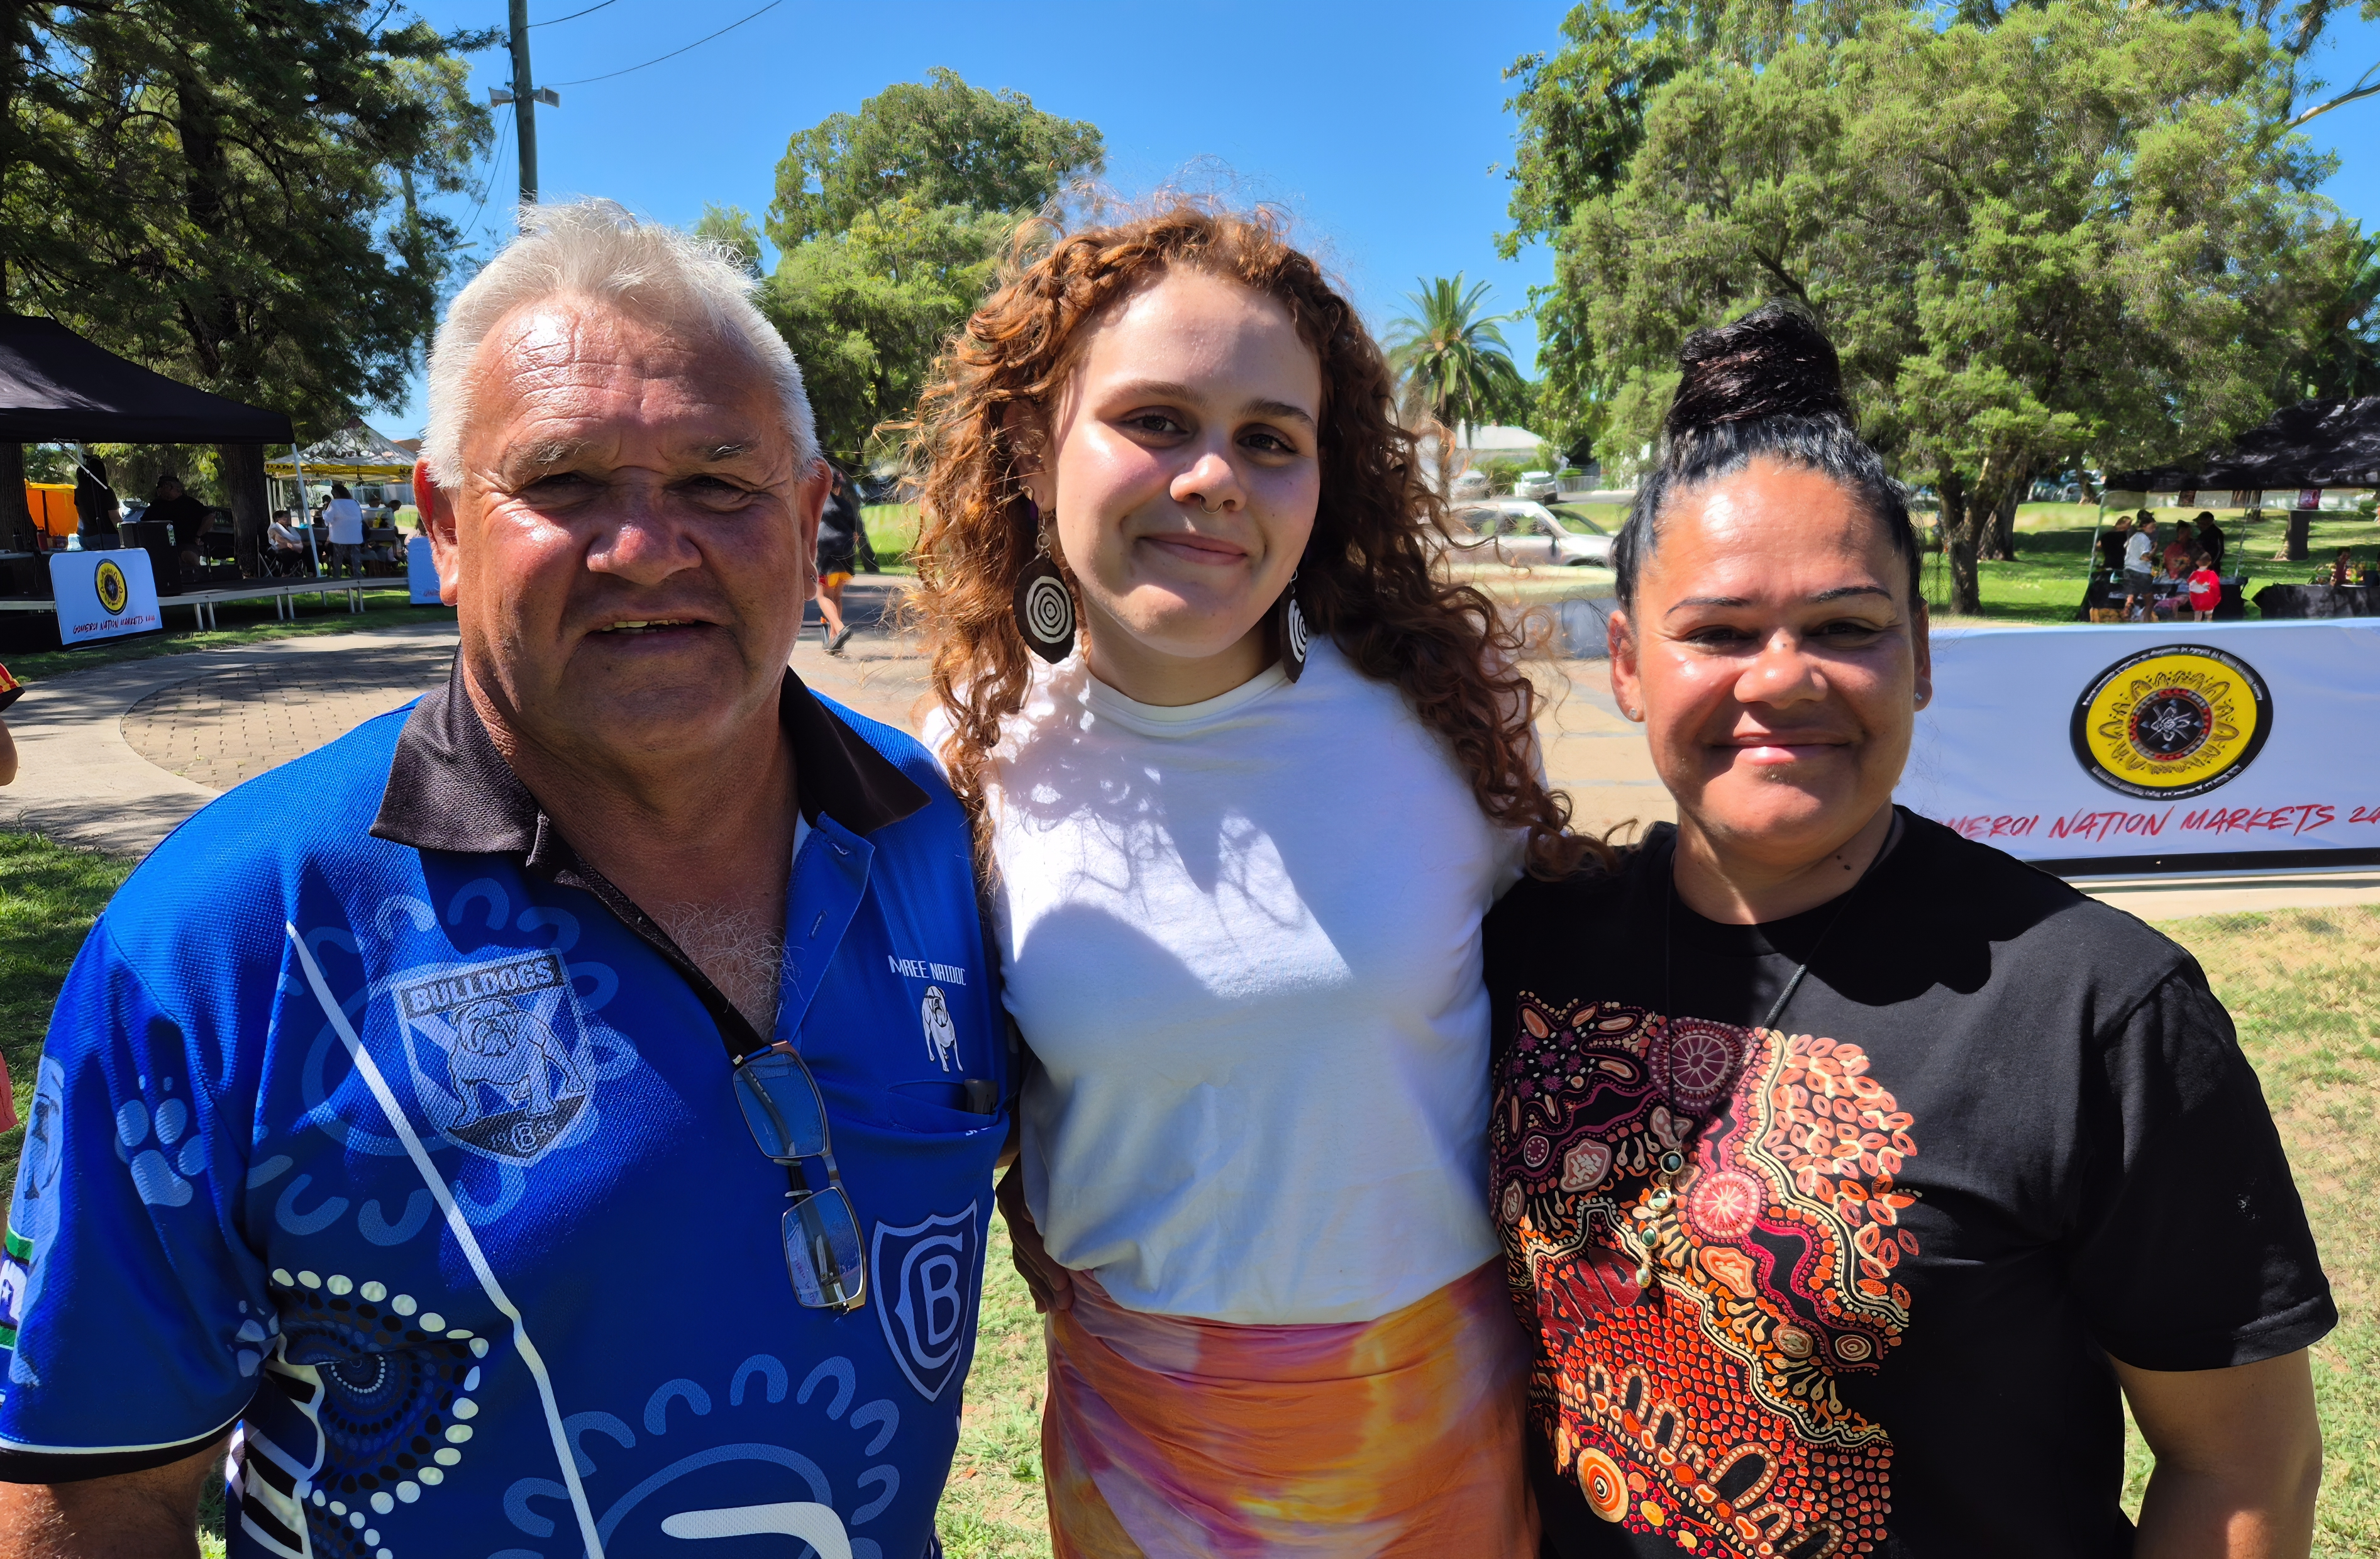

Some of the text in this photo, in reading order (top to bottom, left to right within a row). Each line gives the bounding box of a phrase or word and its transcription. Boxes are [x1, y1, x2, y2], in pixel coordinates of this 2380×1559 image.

[1940, 814, 2039, 840] MEROI
[2048, 805, 2175, 842] NATION
[2180, 804, 2335, 836] MARKETS
[407, 959, 554, 1013] BULLDOGS
[929, 962, 966, 986] NAIDOC
[1534, 1247, 1642, 1347] KIND
